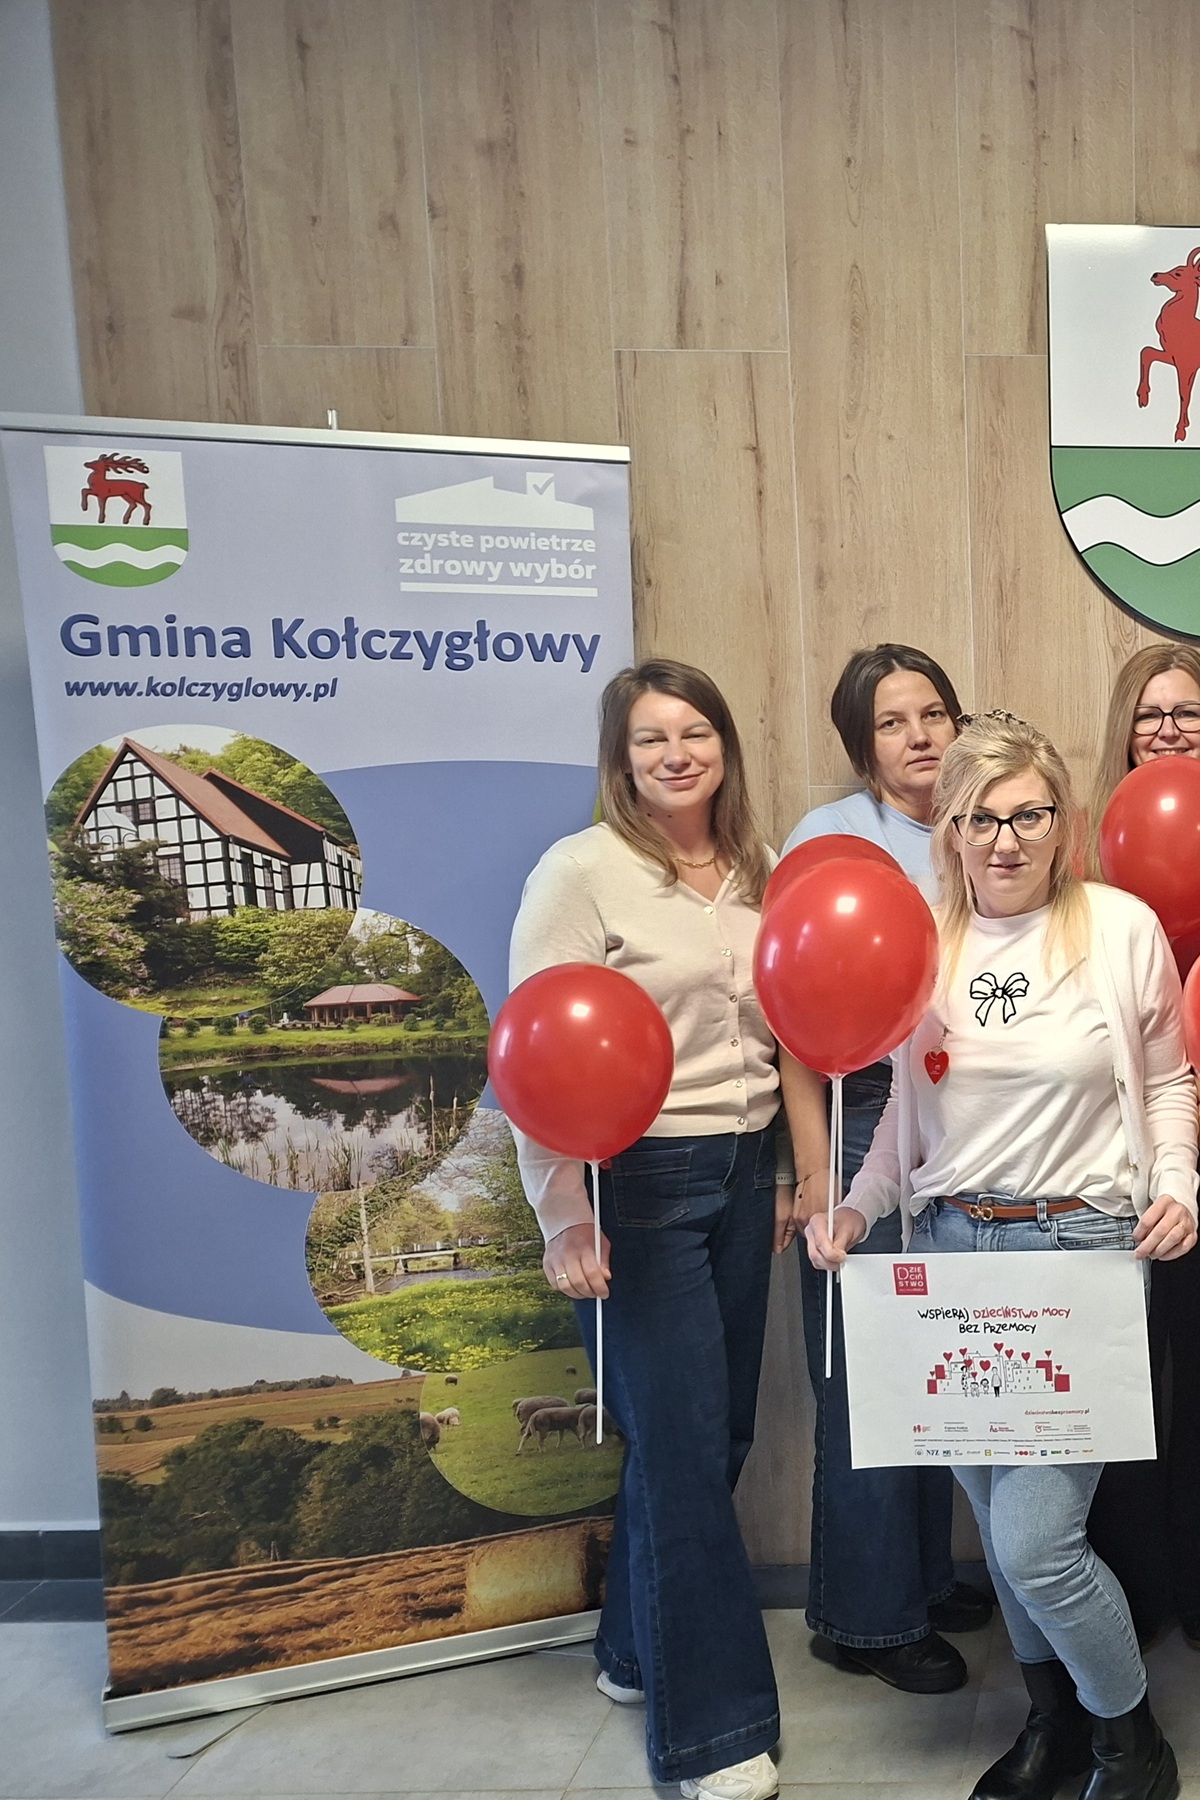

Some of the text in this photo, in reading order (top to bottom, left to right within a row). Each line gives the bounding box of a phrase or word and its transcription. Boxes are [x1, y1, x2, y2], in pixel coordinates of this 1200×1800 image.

[396, 530, 596, 554] czyste powietrze
[399, 554, 597, 584] zdrowy wybór
[59, 612, 602, 673] Gmina Kołczygłowy
[64, 675, 338, 703] www.kolczyglowy.pl
